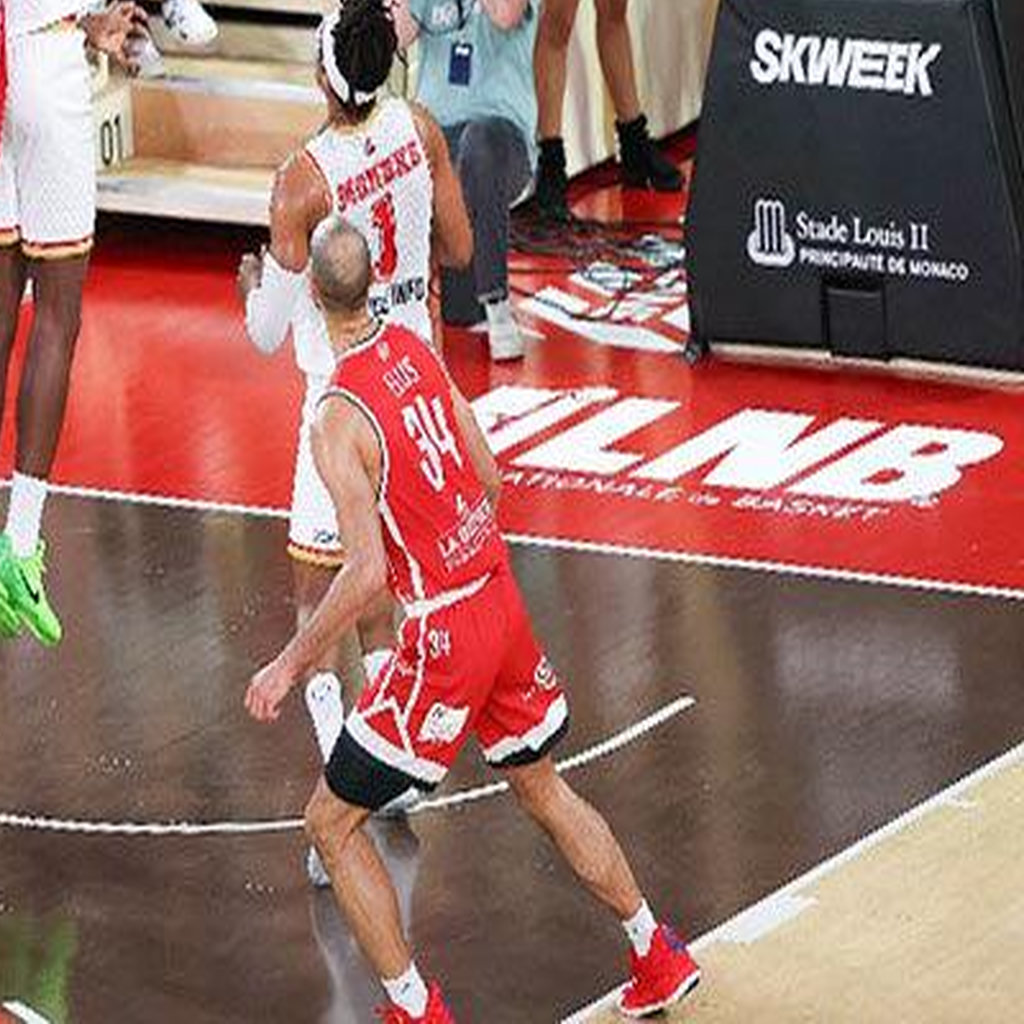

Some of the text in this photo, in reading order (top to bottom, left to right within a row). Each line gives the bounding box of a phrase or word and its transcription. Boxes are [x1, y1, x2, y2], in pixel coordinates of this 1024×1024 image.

[749, 28, 942, 97] SKWEEK
[99, 114, 124, 166] 01
[796, 211, 848, 244] Stade
[853, 217, 905, 249] Louis
[887, 255, 906, 274] DE
[909, 259, 969, 281] MONACO
[401, 394, 463, 493] 34
[509, 396, 1005, 501] LNB
[502, 471, 681, 501] ATIONALE
[427, 628, 451, 659] 34
